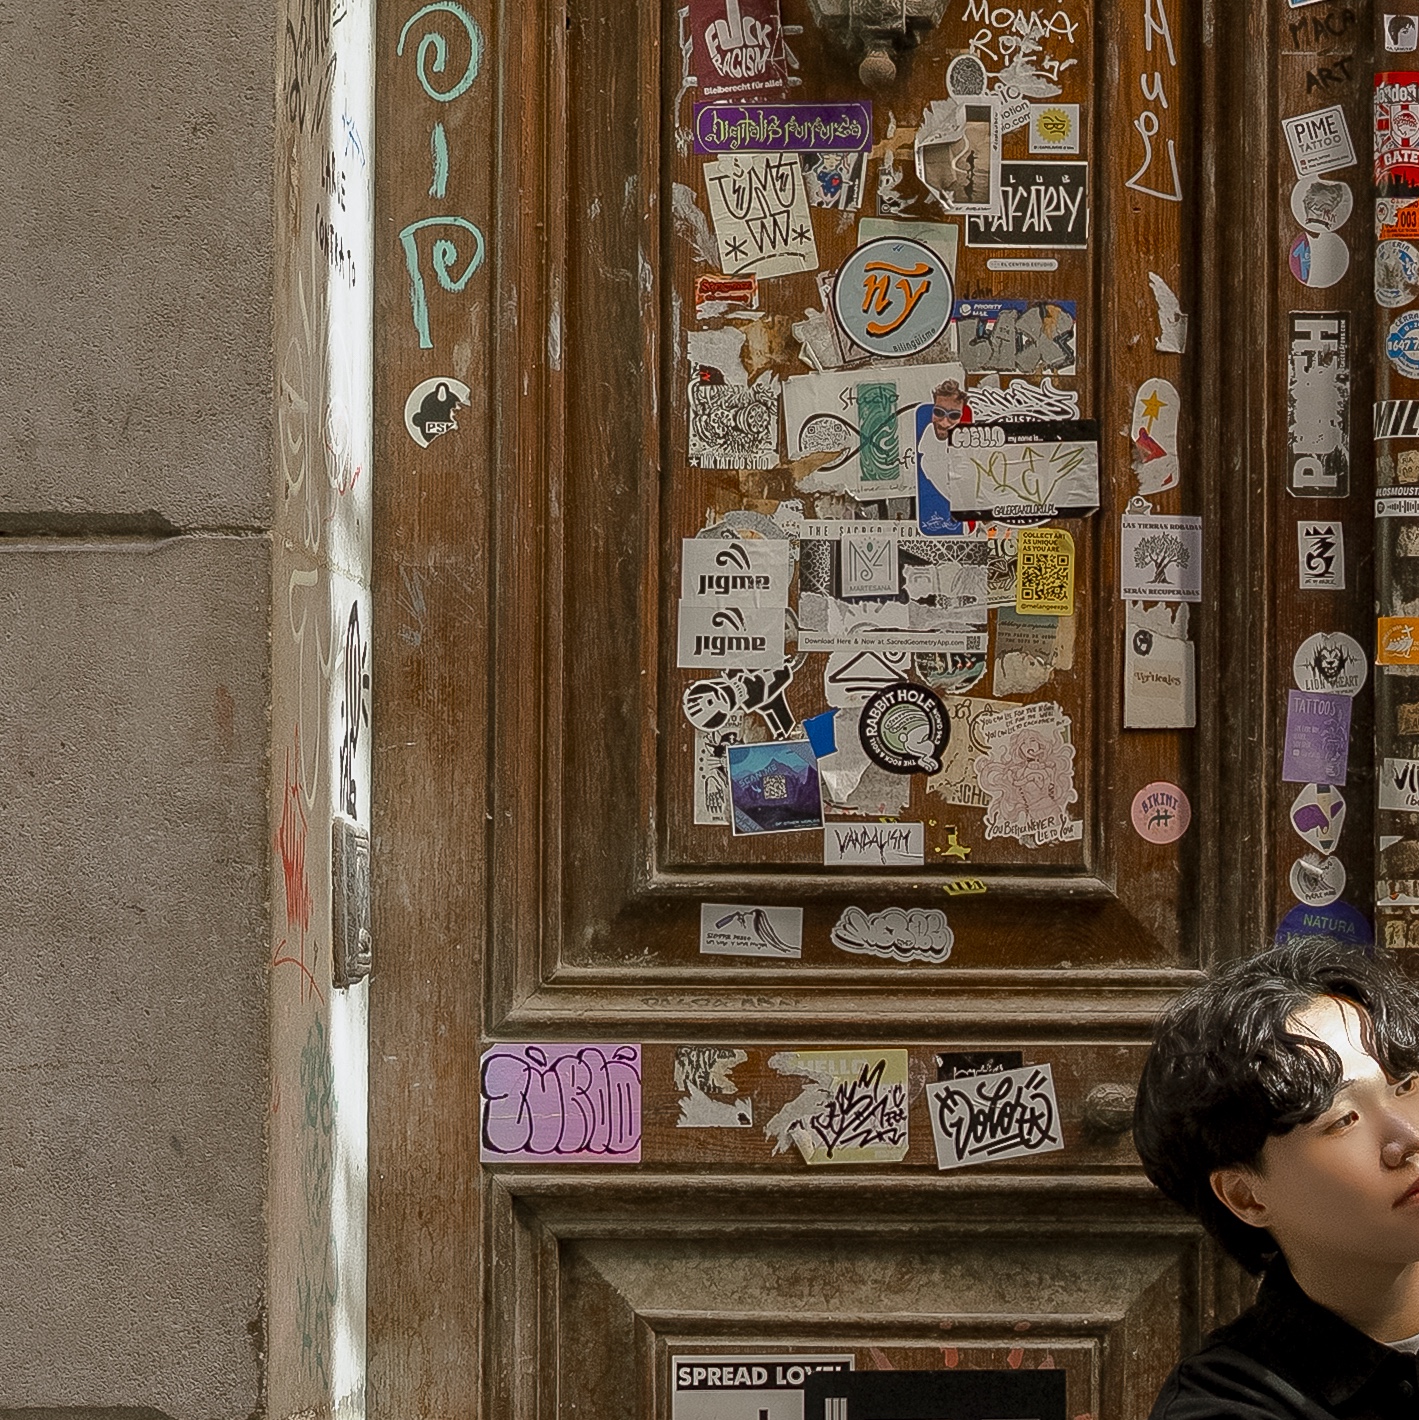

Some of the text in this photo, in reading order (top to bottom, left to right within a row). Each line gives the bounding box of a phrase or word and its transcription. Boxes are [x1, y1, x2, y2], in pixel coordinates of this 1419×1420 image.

[705, 0, 772, 58] FUCK
[711, 47, 771, 79] RACISM
[703, 82, 751, 96] Bleiberecht
[751, 81, 764, 92] für
[1293, 114, 1339, 145] PIME
[1298, 134, 1342, 153] TATTOO
[1400, 213, 1416, 227] 003
[951, 425, 1006, 448] HELLO
[1007, 435, 1018, 443] my
[716, 456, 745, 470] TATTOO
[808, 525, 829, 537] THE
[1122, 522, 1137, 530] LAS
[1138, 522, 1169, 530] TIERRAS
[1022, 532, 1053, 540] COLLECT
[849, 584, 892, 592] MARTESANA
[1123, 587, 1201, 596] SERÁN RECUPERADAS
[804, 637, 835, 645] Download
[837, 637, 852, 645] Here
[861, 637, 876, 645] Now
[1305, 679, 1326, 691] LION
[866, 691, 896, 736] RABBIT
[897, 689, 936, 712] HOLE
[1293, 697, 1337, 717] TATTOOS
[737, 763, 779, 789] SCAN ME
[1141, 791, 1180, 814] BIKINI
[1027, 816, 1055, 832] NEVER
[834, 826, 913, 864] VANDALISM
[1302, 912, 1356, 934] NATURA
[678, 1366, 769, 1387] SPREAD
